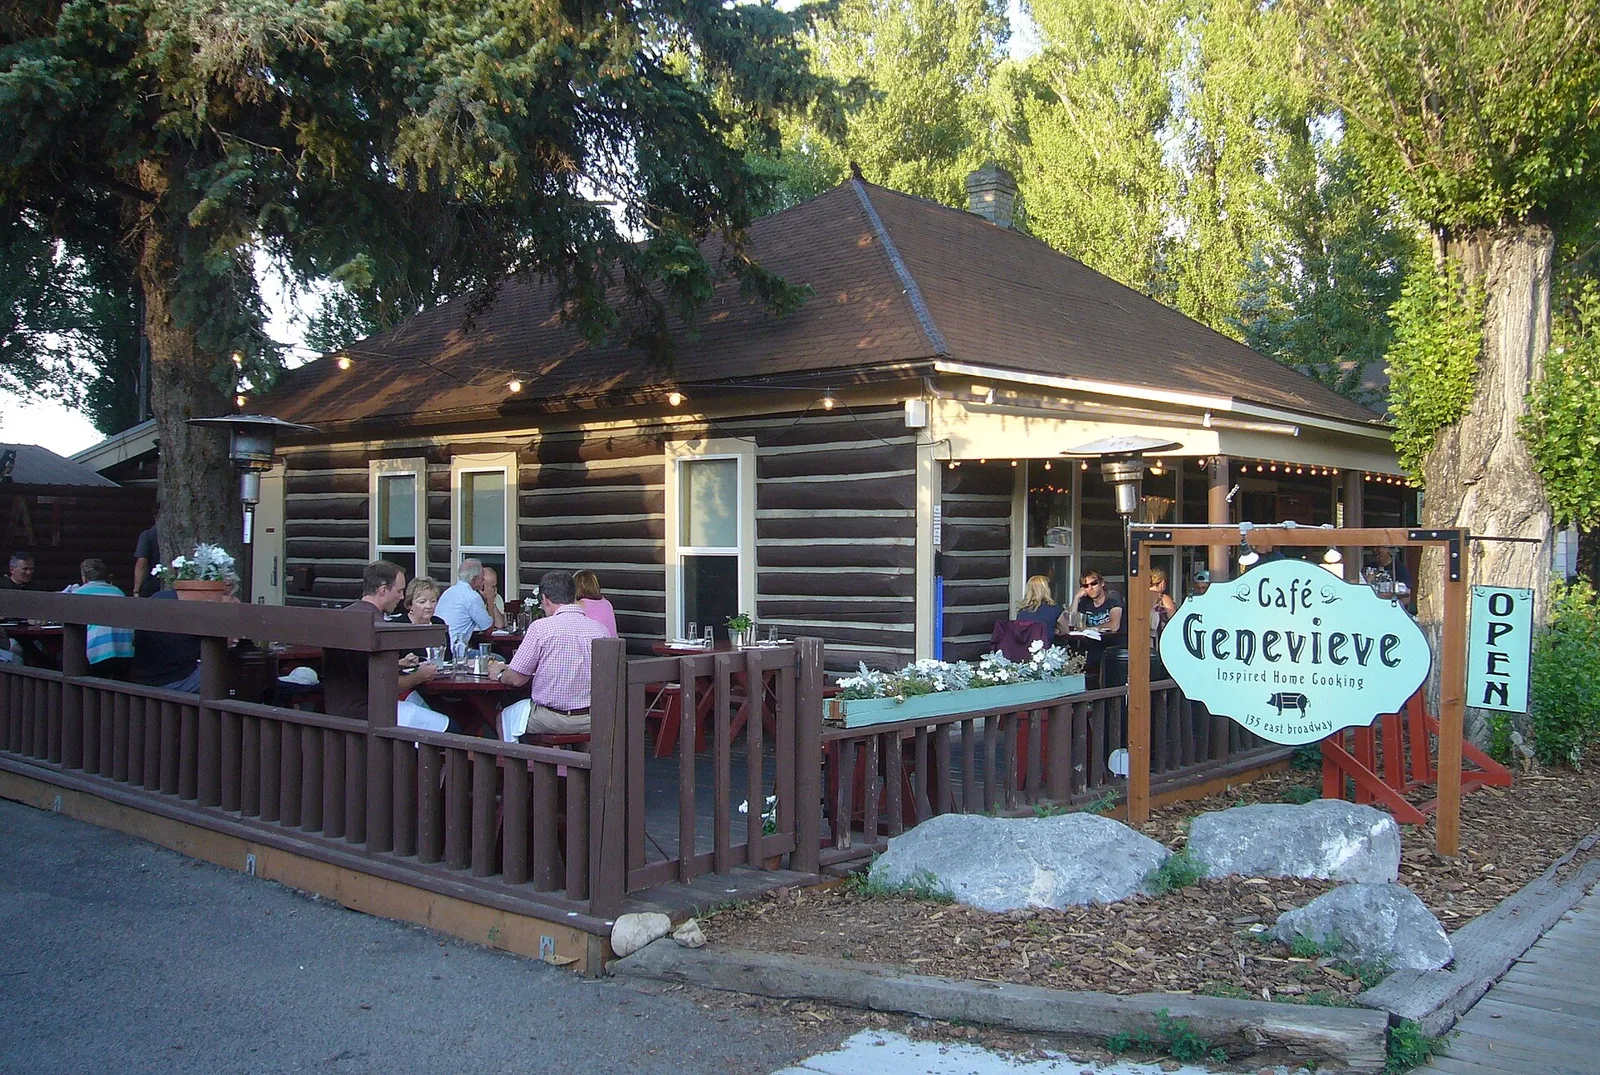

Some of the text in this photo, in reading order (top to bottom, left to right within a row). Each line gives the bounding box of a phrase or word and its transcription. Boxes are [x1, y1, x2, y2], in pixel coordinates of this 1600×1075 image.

[1258, 577, 1313, 615] Café
[1182, 612, 1402, 668] Genevieve
[1482, 592, 1515, 707] OPEN
[1217, 667, 1365, 691] Inspired Home Cooking
[1244, 713, 1334, 735] 135 east broadway
